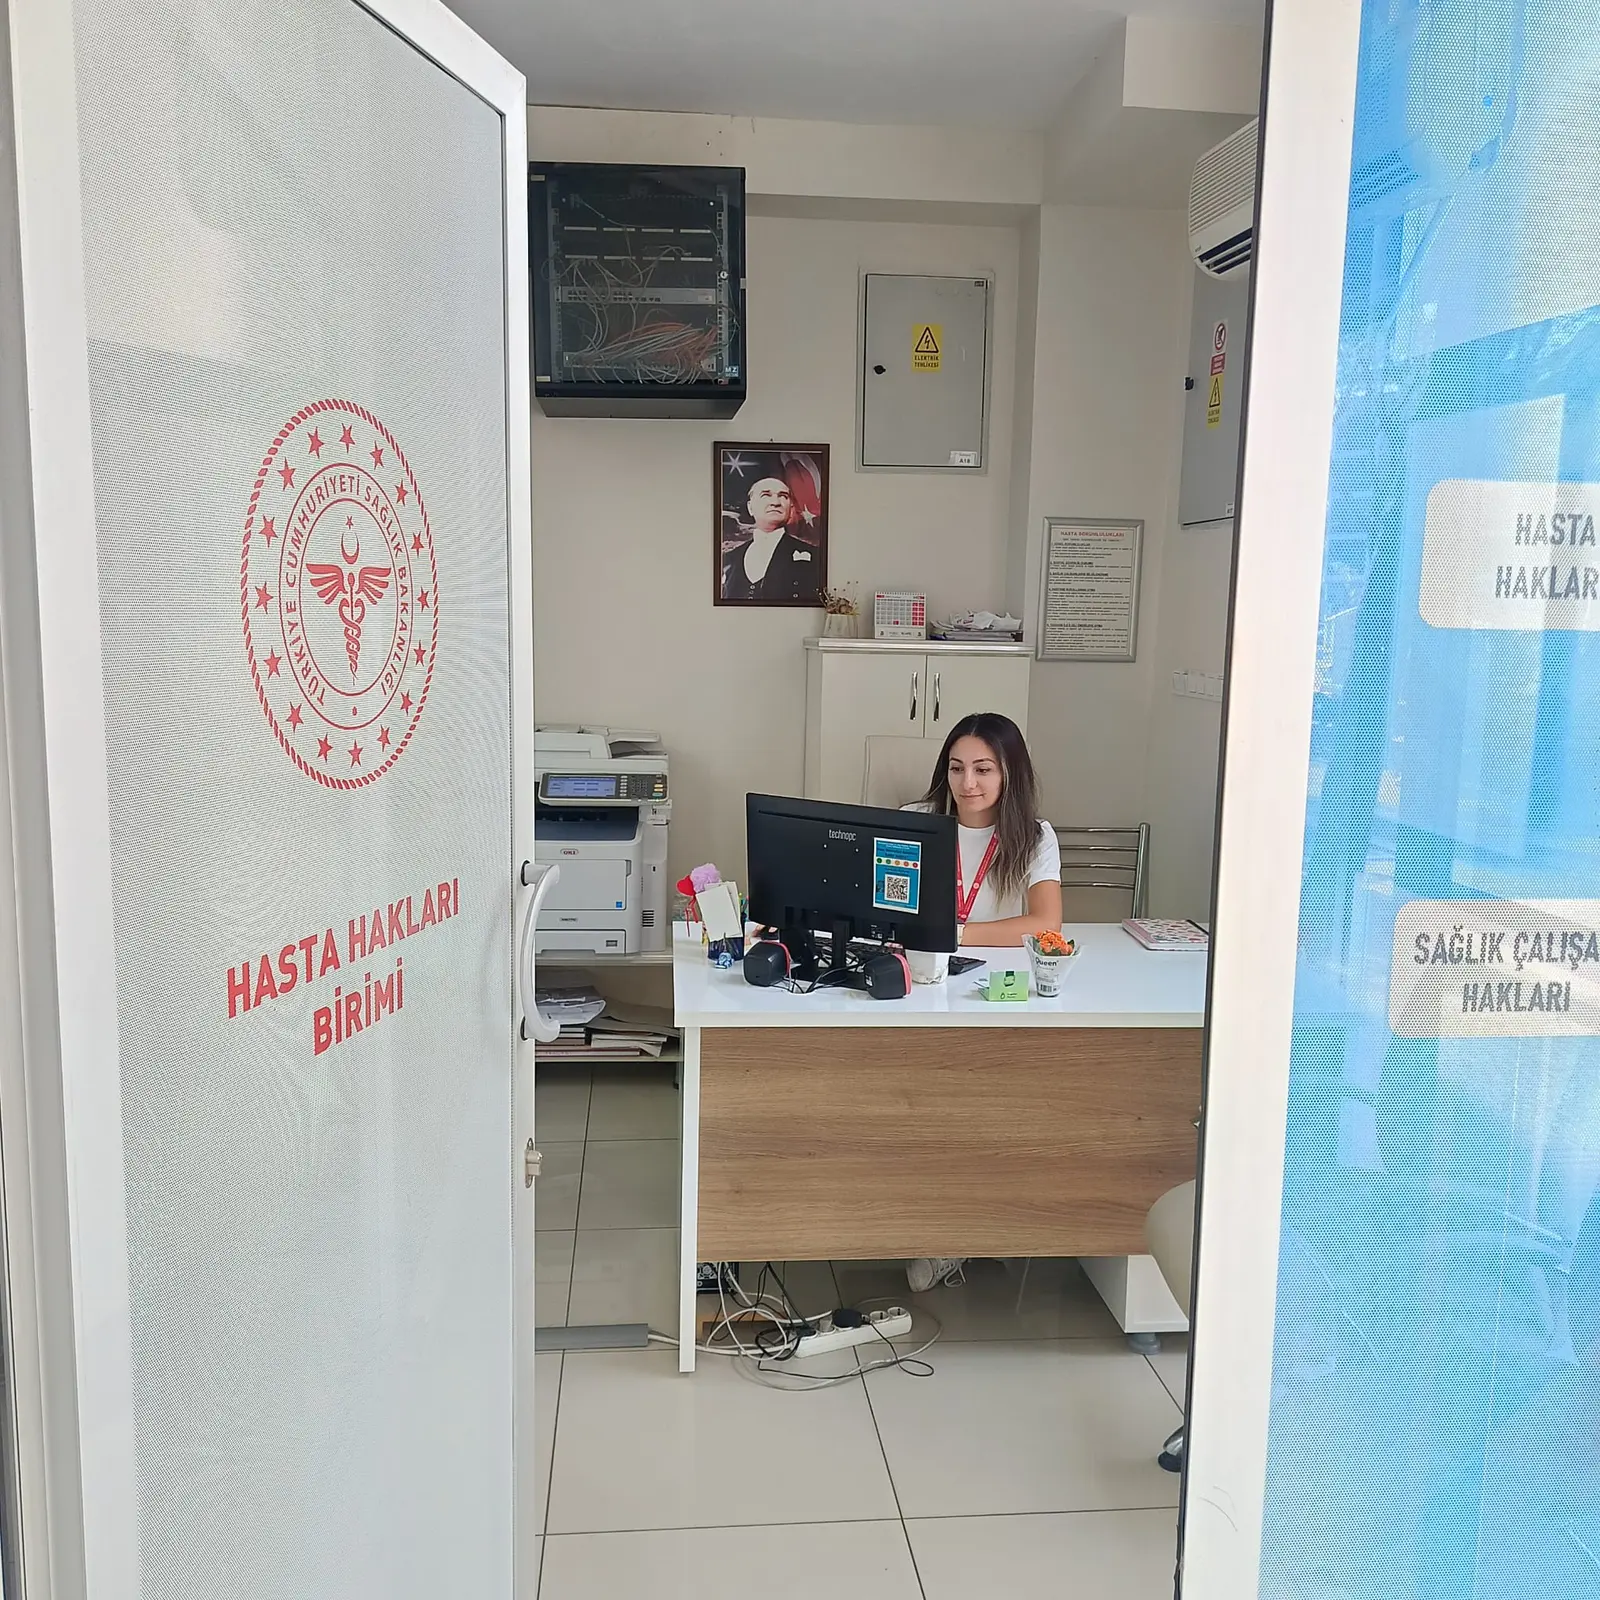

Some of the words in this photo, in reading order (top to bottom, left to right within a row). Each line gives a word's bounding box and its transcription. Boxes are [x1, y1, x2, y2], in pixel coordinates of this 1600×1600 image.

[286, 474, 360, 588] CUMHURİYETİ
[364, 486, 403, 559] SAĞLIK
[1514, 513, 1596, 547] HASTA
[286, 600, 326, 706] TÜRKİYE
[380, 566, 409, 696] BAKANLIĞI
[828, 829, 857, 842] technopc
[226, 928, 341, 1019] HASTA
[348, 877, 460, 963] HAKLARI
[1414, 924, 1505, 965] SAĞLIK
[313, 957, 405, 1057] BİRİMİ
[1462, 981, 1571, 1013] HAKLARI
